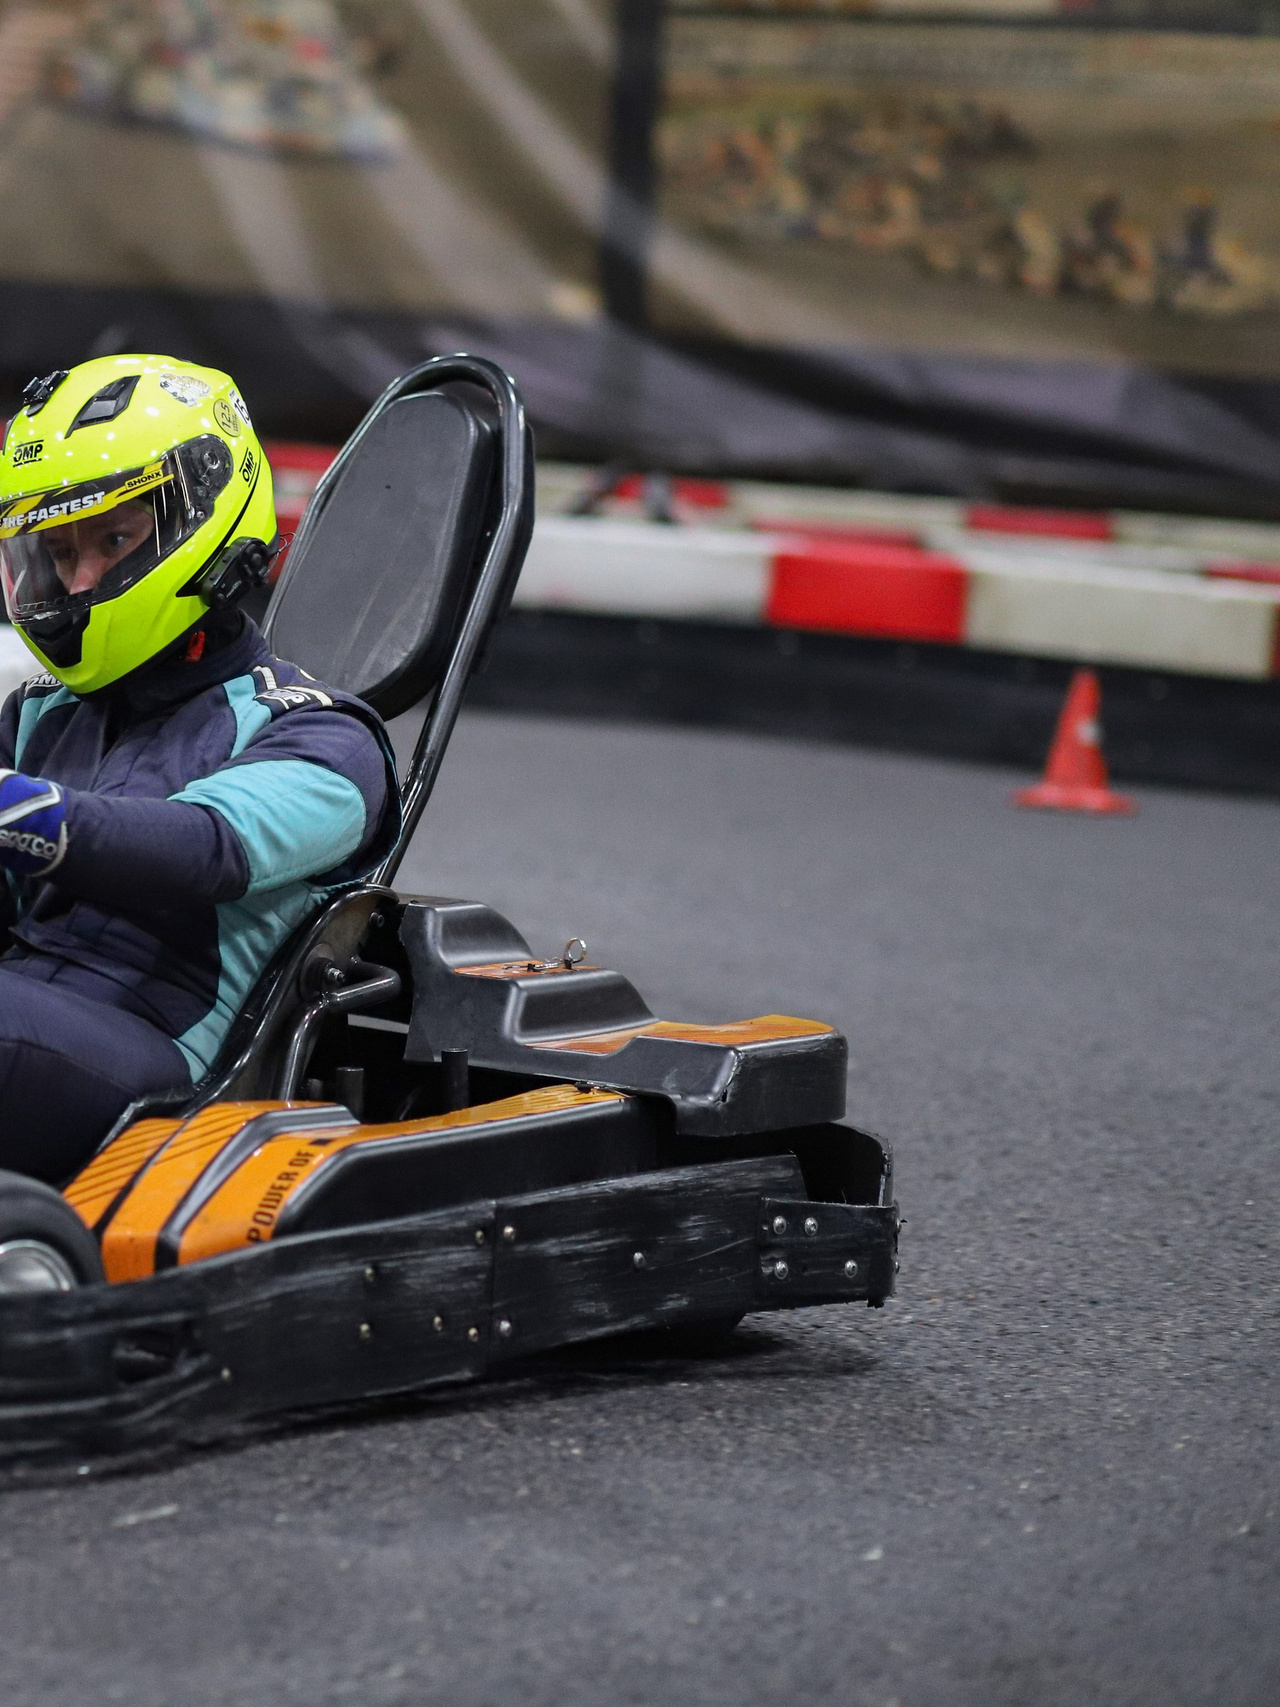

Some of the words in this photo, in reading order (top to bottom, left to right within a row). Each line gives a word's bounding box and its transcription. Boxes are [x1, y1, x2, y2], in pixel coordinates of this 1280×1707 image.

[220, 402, 231, 429] 12.5
[13, 443, 43, 463] OMP
[242, 452, 254, 483] OMP
[127, 471, 161, 488] SHONX
[2, 514, 25, 529] THE
[27, 491, 106, 524] FASTEST
[247, 1171, 299, 1242] POWER
[288, 1149, 314, 1167] OF
